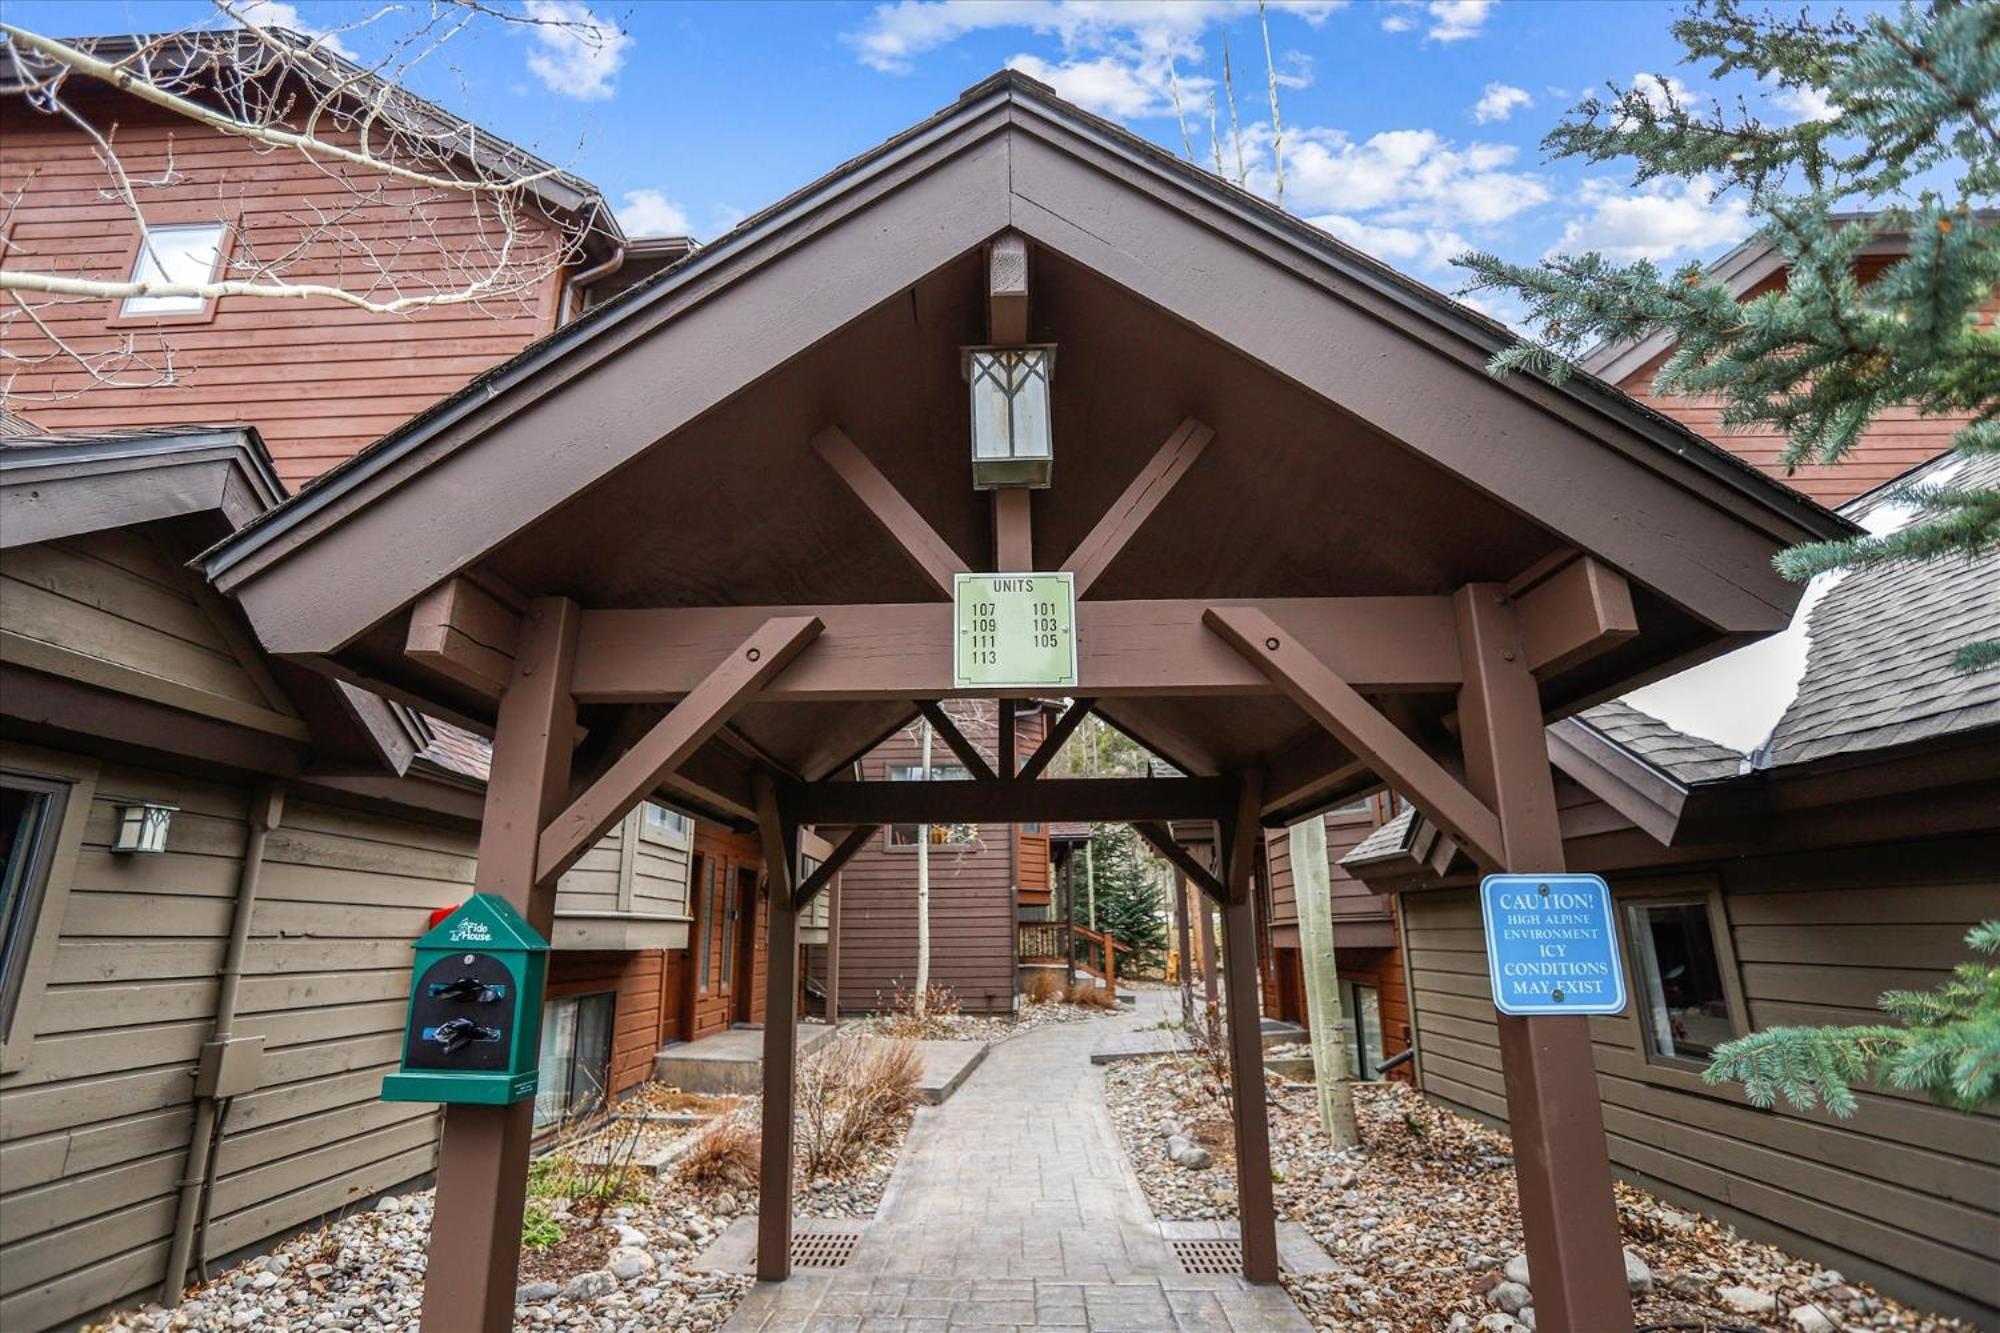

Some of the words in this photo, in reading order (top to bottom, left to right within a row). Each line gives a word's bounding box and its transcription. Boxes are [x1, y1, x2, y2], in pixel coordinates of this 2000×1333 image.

[993, 580, 1034, 592] UNITS
[972, 603, 996, 616] 107
[1033, 602, 1056, 615] 101
[972, 619, 996, 632] 109
[1033, 618, 1057, 631] 103
[972, 635, 996, 648] 111
[1034, 634, 1058, 647] 105
[972, 651, 996, 664] 113
[1500, 893, 1595, 910] CAUTION!
[1507, 914, 1540, 925] HIGH
[1545, 914, 1591, 925] ALPINE
[461, 931, 492, 941] House
[1504, 928, 1599, 940] ENVIRONMENT
[1539, 944, 1567, 958] ICY
[1503, 961, 1608, 976] CONDITIONS
[1513, 979, 1549, 994] MAY
[1556, 979, 1604, 994] EXIST
